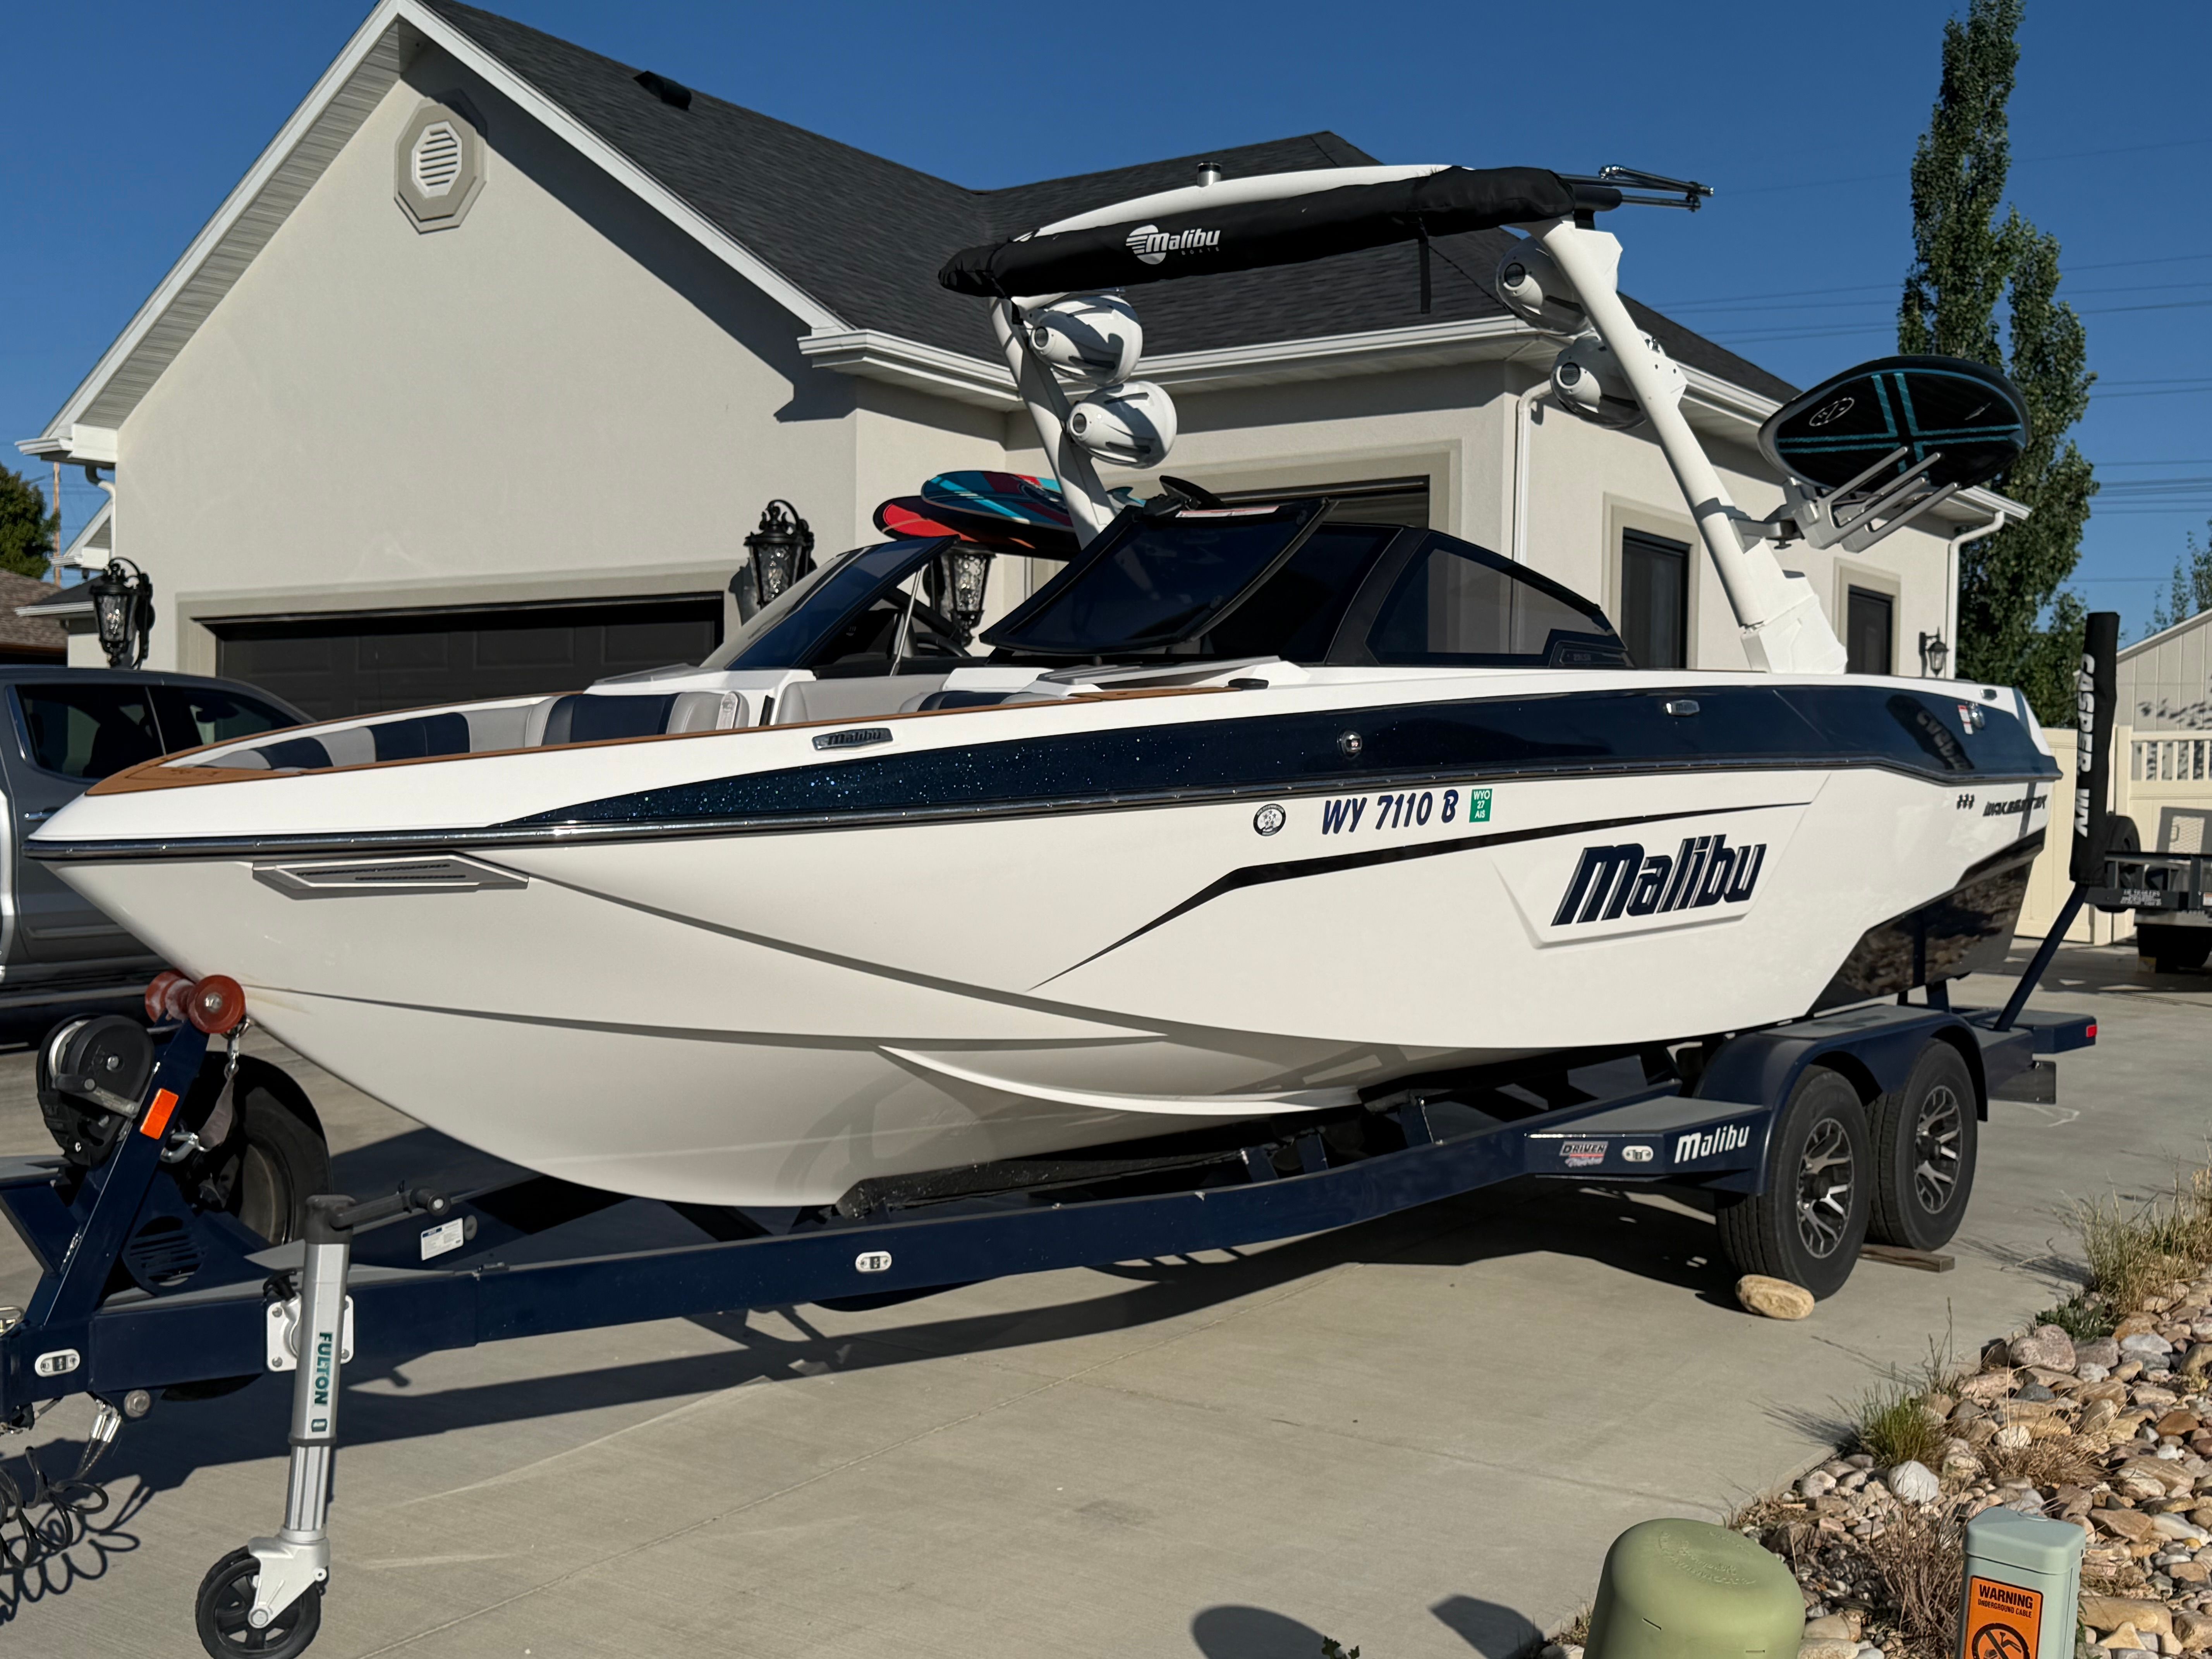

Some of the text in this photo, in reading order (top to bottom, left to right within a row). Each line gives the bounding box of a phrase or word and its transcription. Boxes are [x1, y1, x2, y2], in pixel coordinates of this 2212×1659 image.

[1146, 228, 1221, 252] Malibu
[828, 730, 881, 745] Malibu
[1474, 790, 1491, 800] WYO
[1477, 800, 1485, 809] 27
[1322, 797, 1367, 835] WY
[1375, 792, 1433, 830] 7110
[1441, 789, 1459, 823] B
[1475, 810, 1486, 819] AIS
[2074, 788, 2090, 838] WY
[1550, 834, 1767, 927] Malibu
[1562, 1144, 1605, 1154] DRIVEN
[1674, 1124, 1750, 1163] Malibu
[314, 1332, 333, 1406] FULTON
[1978, 1599, 2032, 1618] UNDERGROUND CABLE
[1979, 1584, 2033, 1609] WARNING
